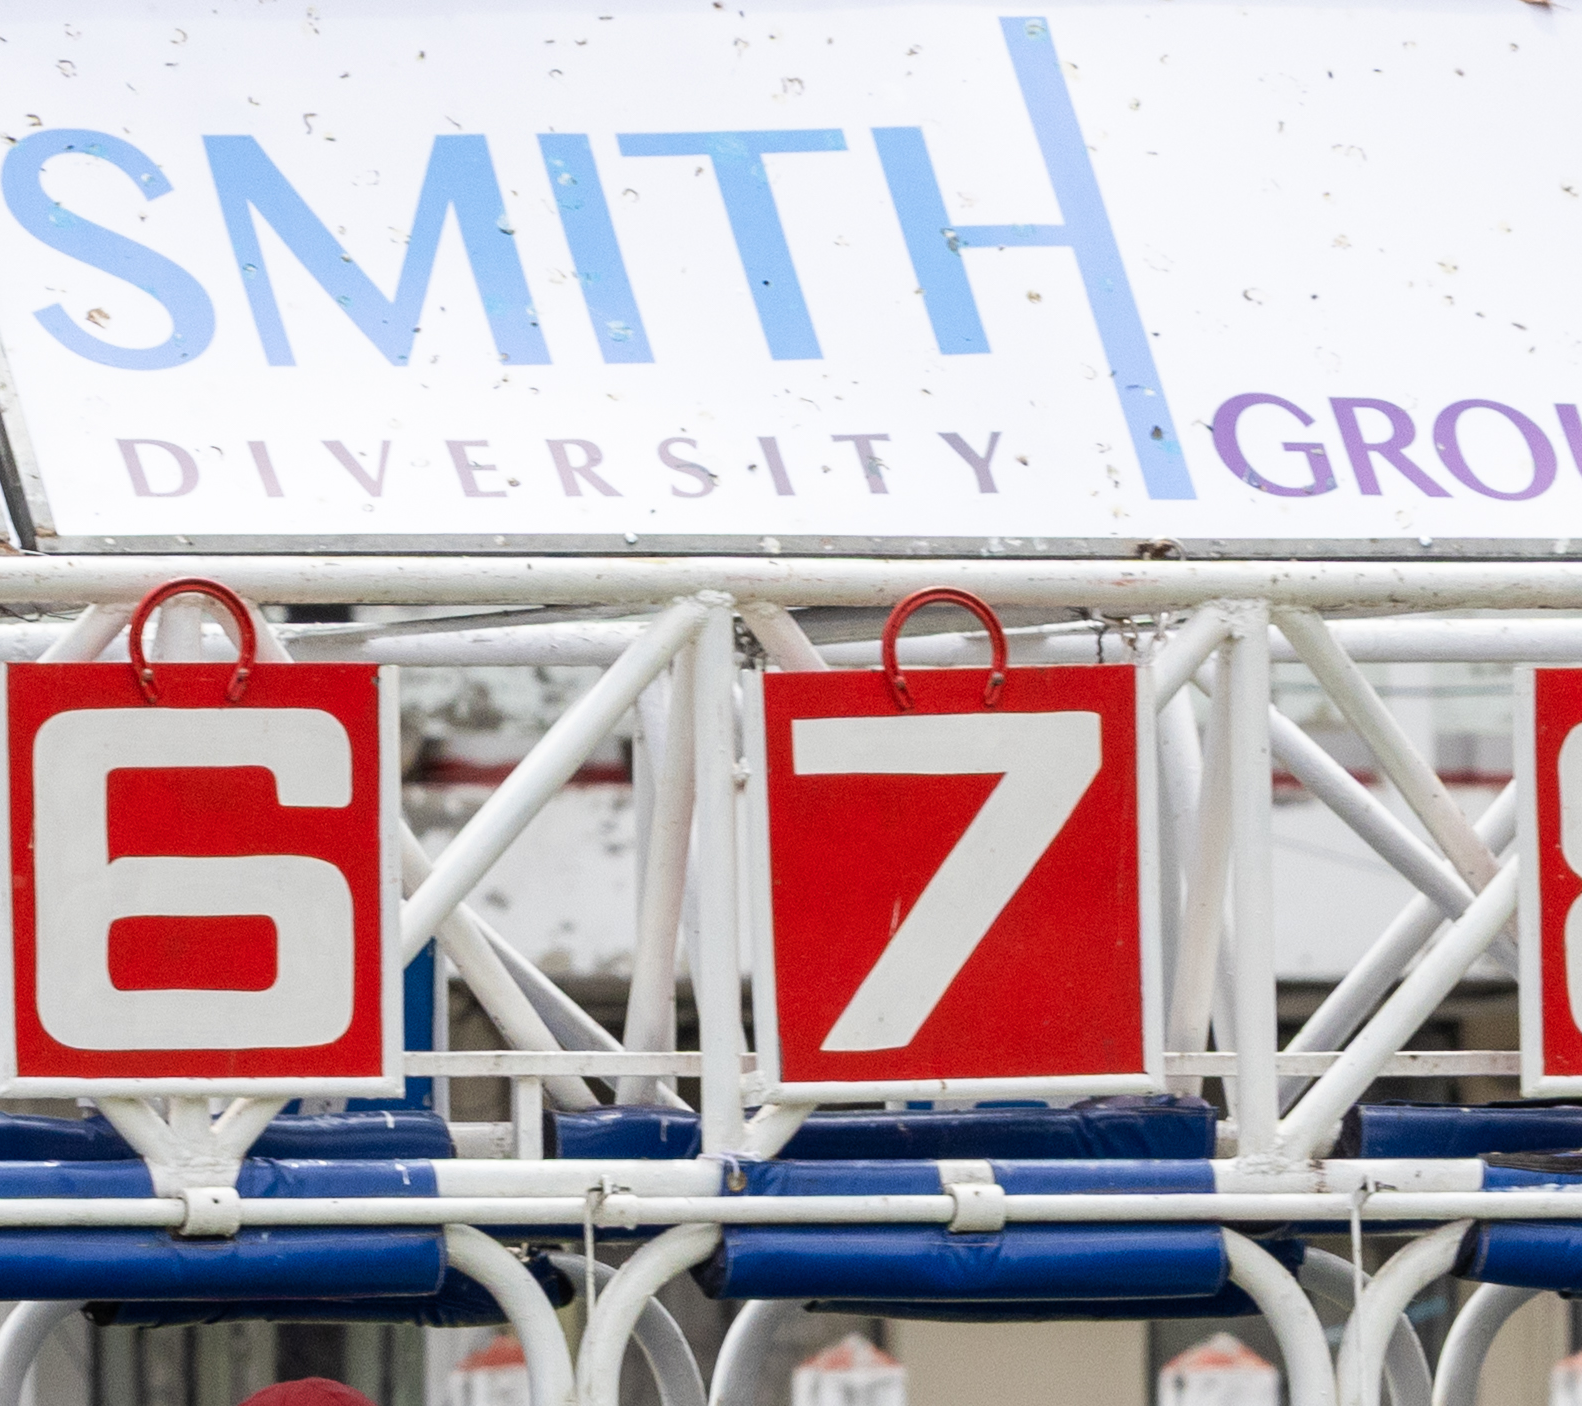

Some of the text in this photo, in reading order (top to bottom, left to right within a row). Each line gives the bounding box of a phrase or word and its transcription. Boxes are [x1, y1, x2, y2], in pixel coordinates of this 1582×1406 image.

[115, 430, 1008, 502] DIVERSITY
[34, 706, 355, 1052] 6
[791, 711, 1103, 1053] 7
